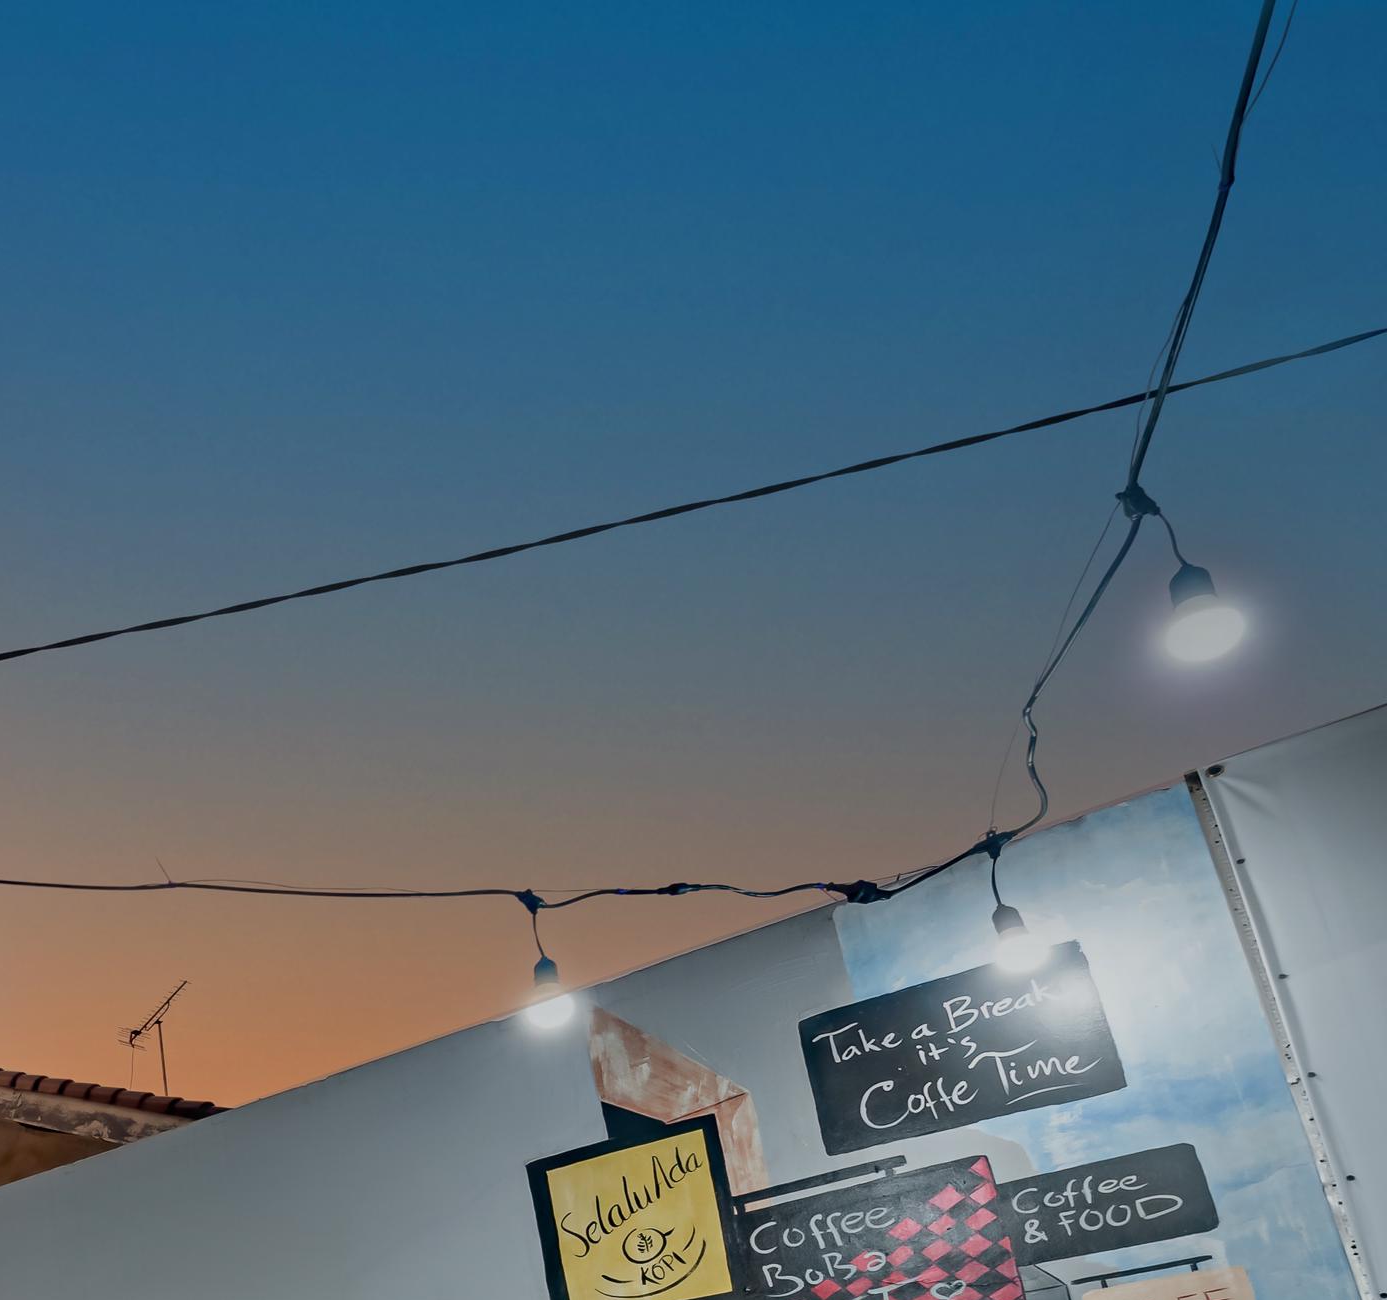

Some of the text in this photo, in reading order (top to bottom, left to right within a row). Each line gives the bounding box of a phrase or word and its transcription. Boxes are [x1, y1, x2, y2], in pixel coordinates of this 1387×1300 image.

[812, 979, 1054, 1063] Take a Break
[918, 1035, 977, 1066] it's
[859, 1039, 1102, 1129] Coffe Time
[1011, 1174, 1148, 1216] Coffee
[1024, 1194, 1184, 1244] & FOOD
[749, 1204, 901, 1256] Coffee
[640, 1251, 687, 1286] KOPI
